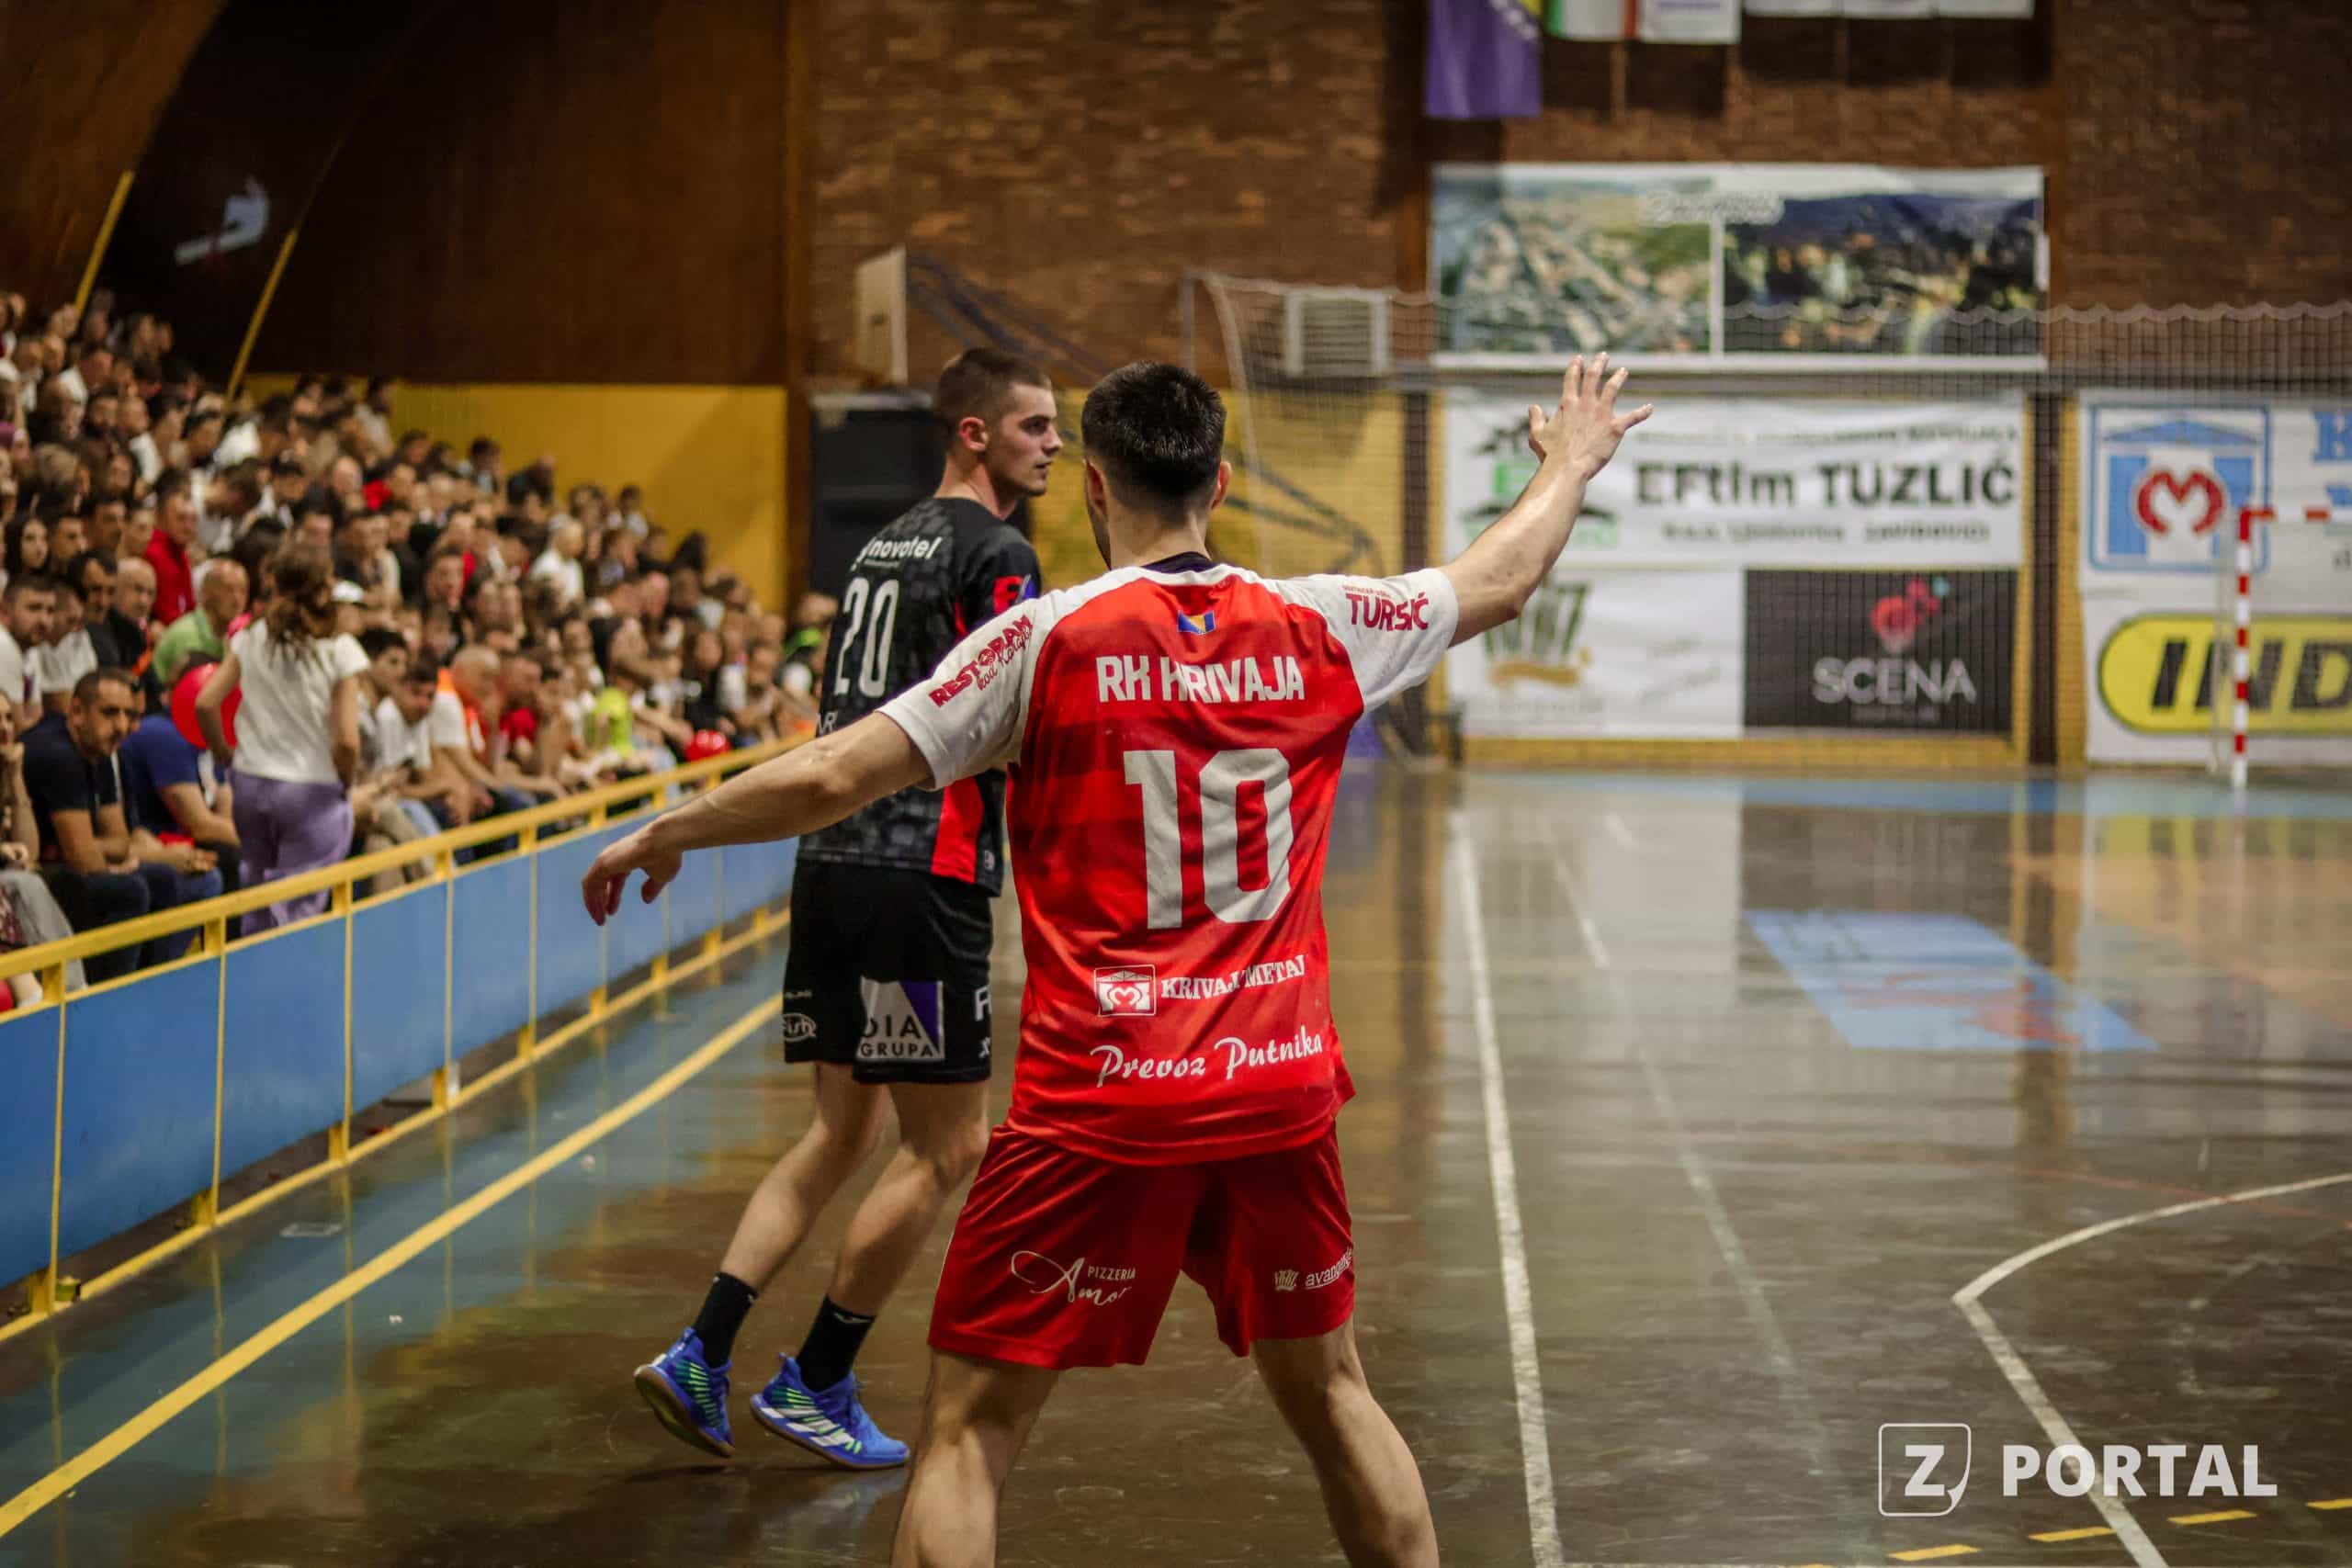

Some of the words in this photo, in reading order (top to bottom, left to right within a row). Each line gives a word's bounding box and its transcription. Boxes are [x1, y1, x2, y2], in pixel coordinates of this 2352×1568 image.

[1815, 449, 2015, 507] TUZLIĆ
[833, 576, 899, 698] 20
[1345, 591, 1430, 632] TURSIĆ
[928, 614, 1034, 708] RESTORAN
[1095, 654, 1152, 704] RK
[1159, 655, 1306, 705] KRIVAJA
[1812, 656, 1977, 705] SCENA
[1124, 748, 1295, 931] 10
[859, 1042, 933, 1057] GRUPA
[1090, 1044, 1206, 1089] Prevoz
[1213, 1024, 1324, 1081] Putnika
[1086, 1266, 1136, 1281] PIZZERIA
